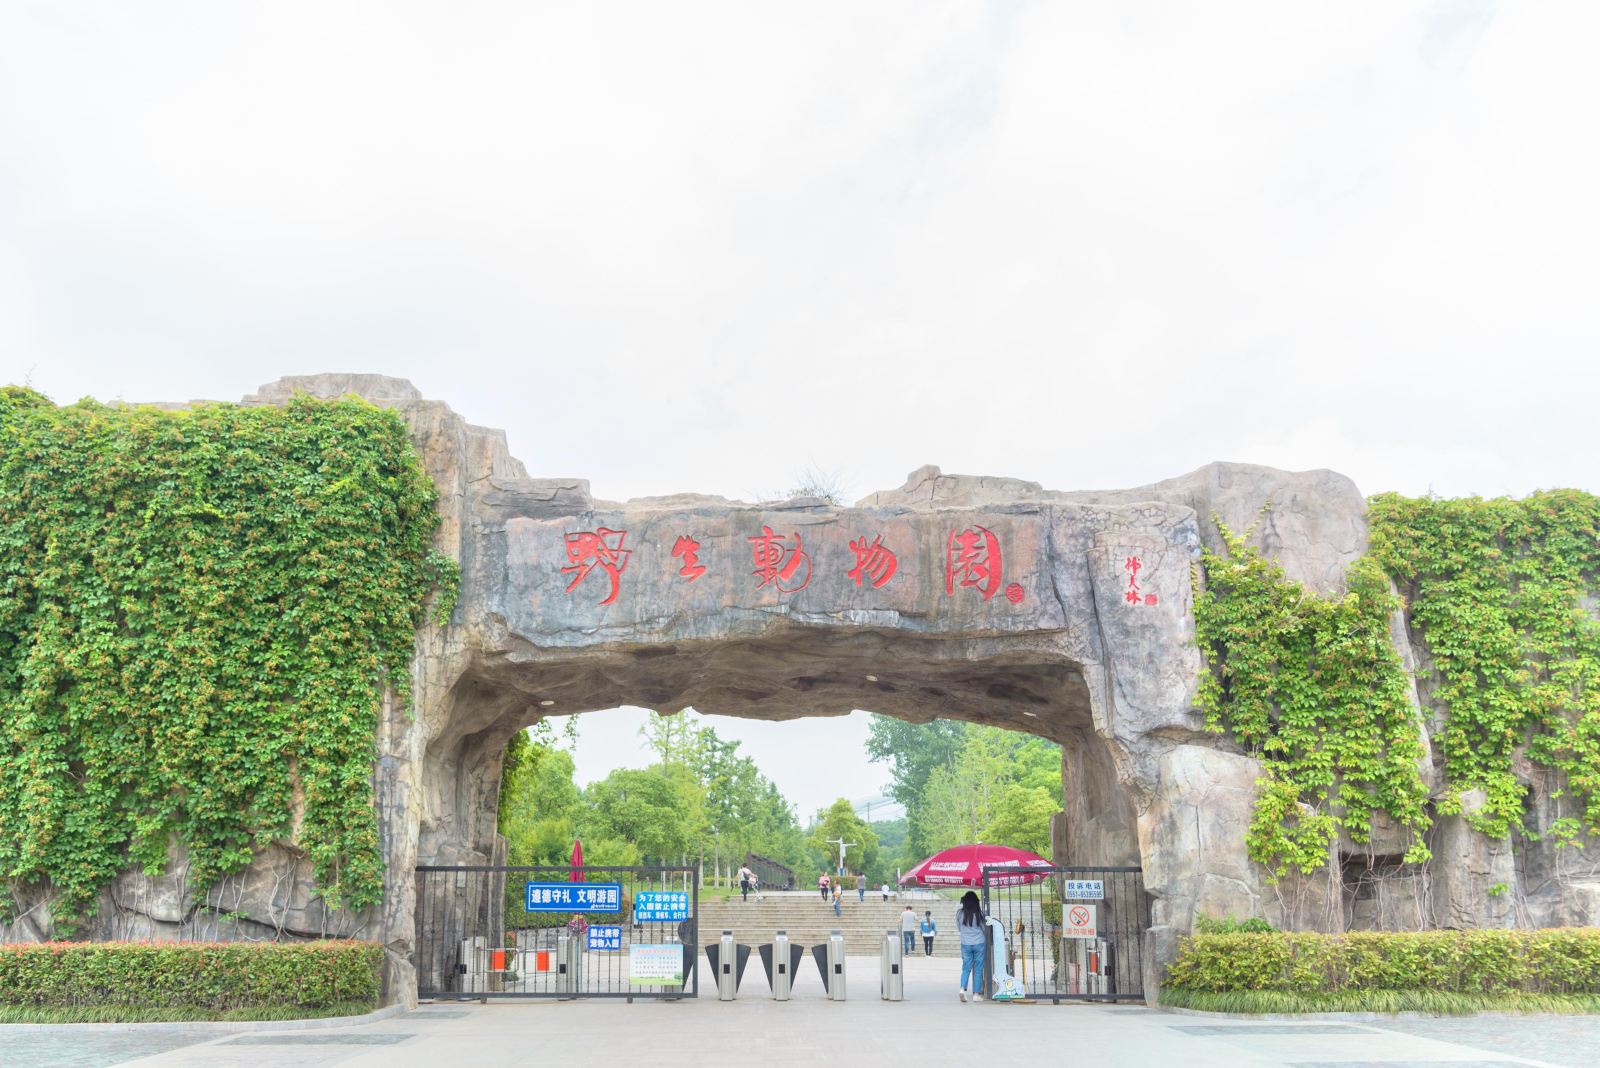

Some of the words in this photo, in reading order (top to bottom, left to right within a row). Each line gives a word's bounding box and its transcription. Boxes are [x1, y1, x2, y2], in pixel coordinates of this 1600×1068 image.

[1068, 882, 1101, 890] 投诉电话
[531, 889, 571, 903] 遵德守礼
[577, 889, 617, 903] 文明游园
[639, 894, 686, 902] 为了您的安全
[590, 928, 619, 938] 禁止携带
[590, 938, 619, 948] 宠物入园
